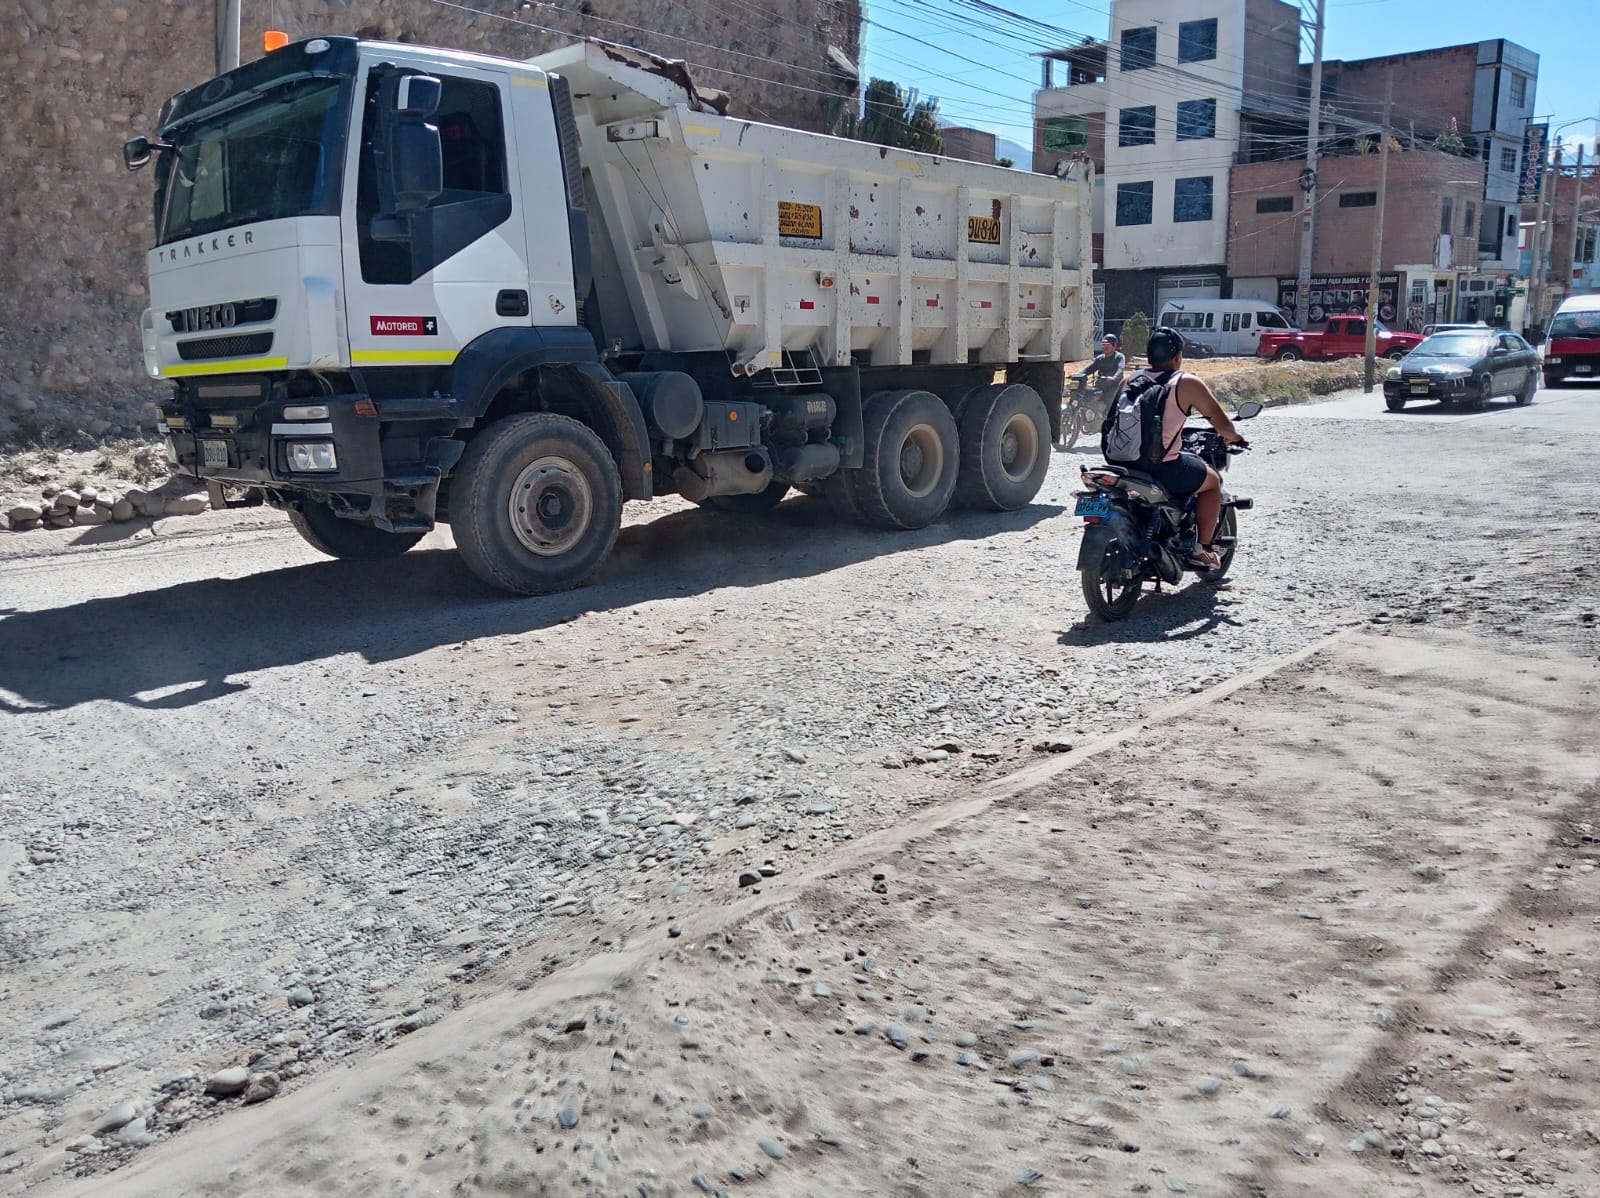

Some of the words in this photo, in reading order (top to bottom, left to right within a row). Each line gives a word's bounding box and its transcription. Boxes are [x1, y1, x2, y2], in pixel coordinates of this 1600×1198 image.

[159, 231, 253, 263] TRAKKER
[184, 303, 236, 333] IVECO
[376, 320, 418, 331] MOTORED
